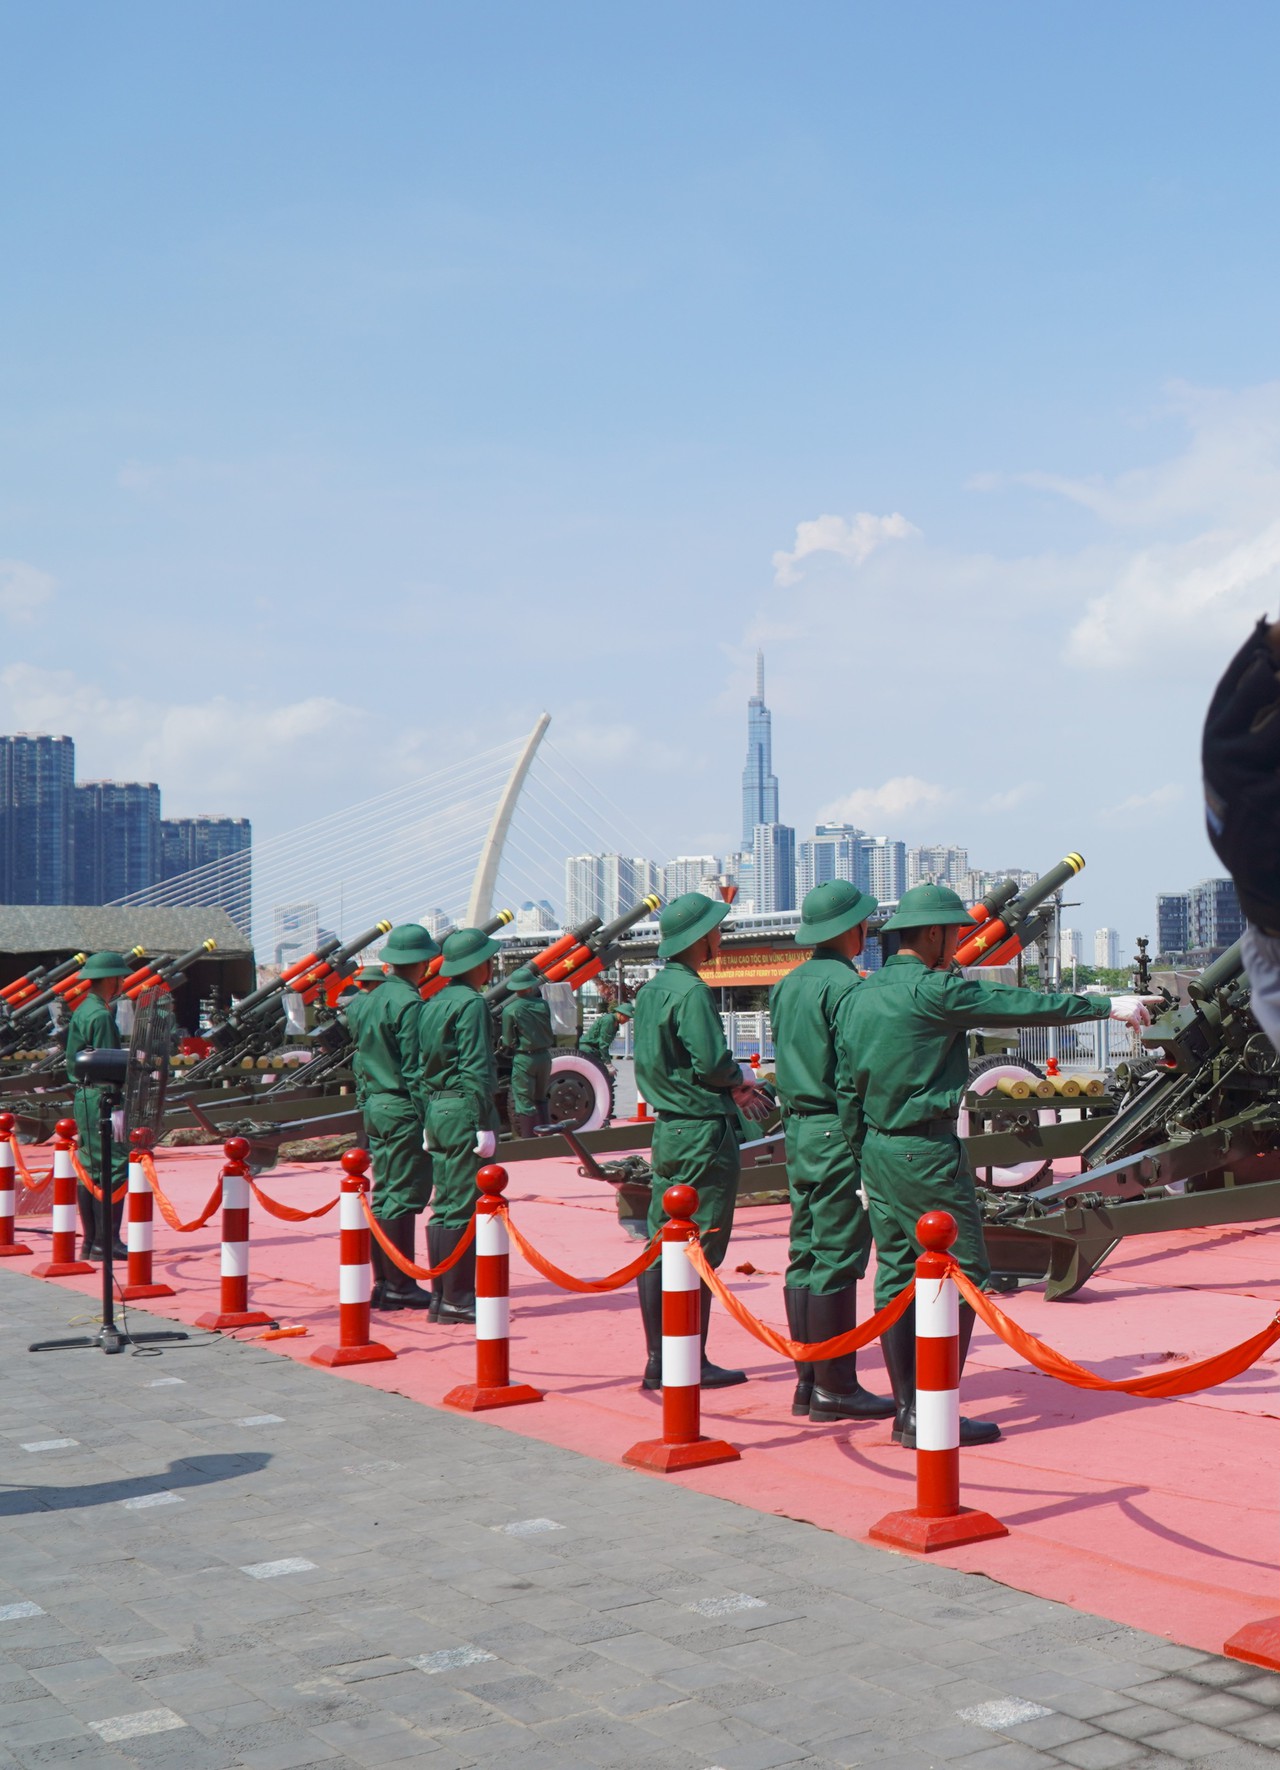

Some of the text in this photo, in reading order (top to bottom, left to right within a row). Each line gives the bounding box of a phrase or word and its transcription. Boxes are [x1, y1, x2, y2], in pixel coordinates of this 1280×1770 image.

[739, 954, 750, 964] CAO
[735, 970, 744, 978] FOR
[745, 970, 756, 978] FAST
[771, 969, 778, 977] TO
